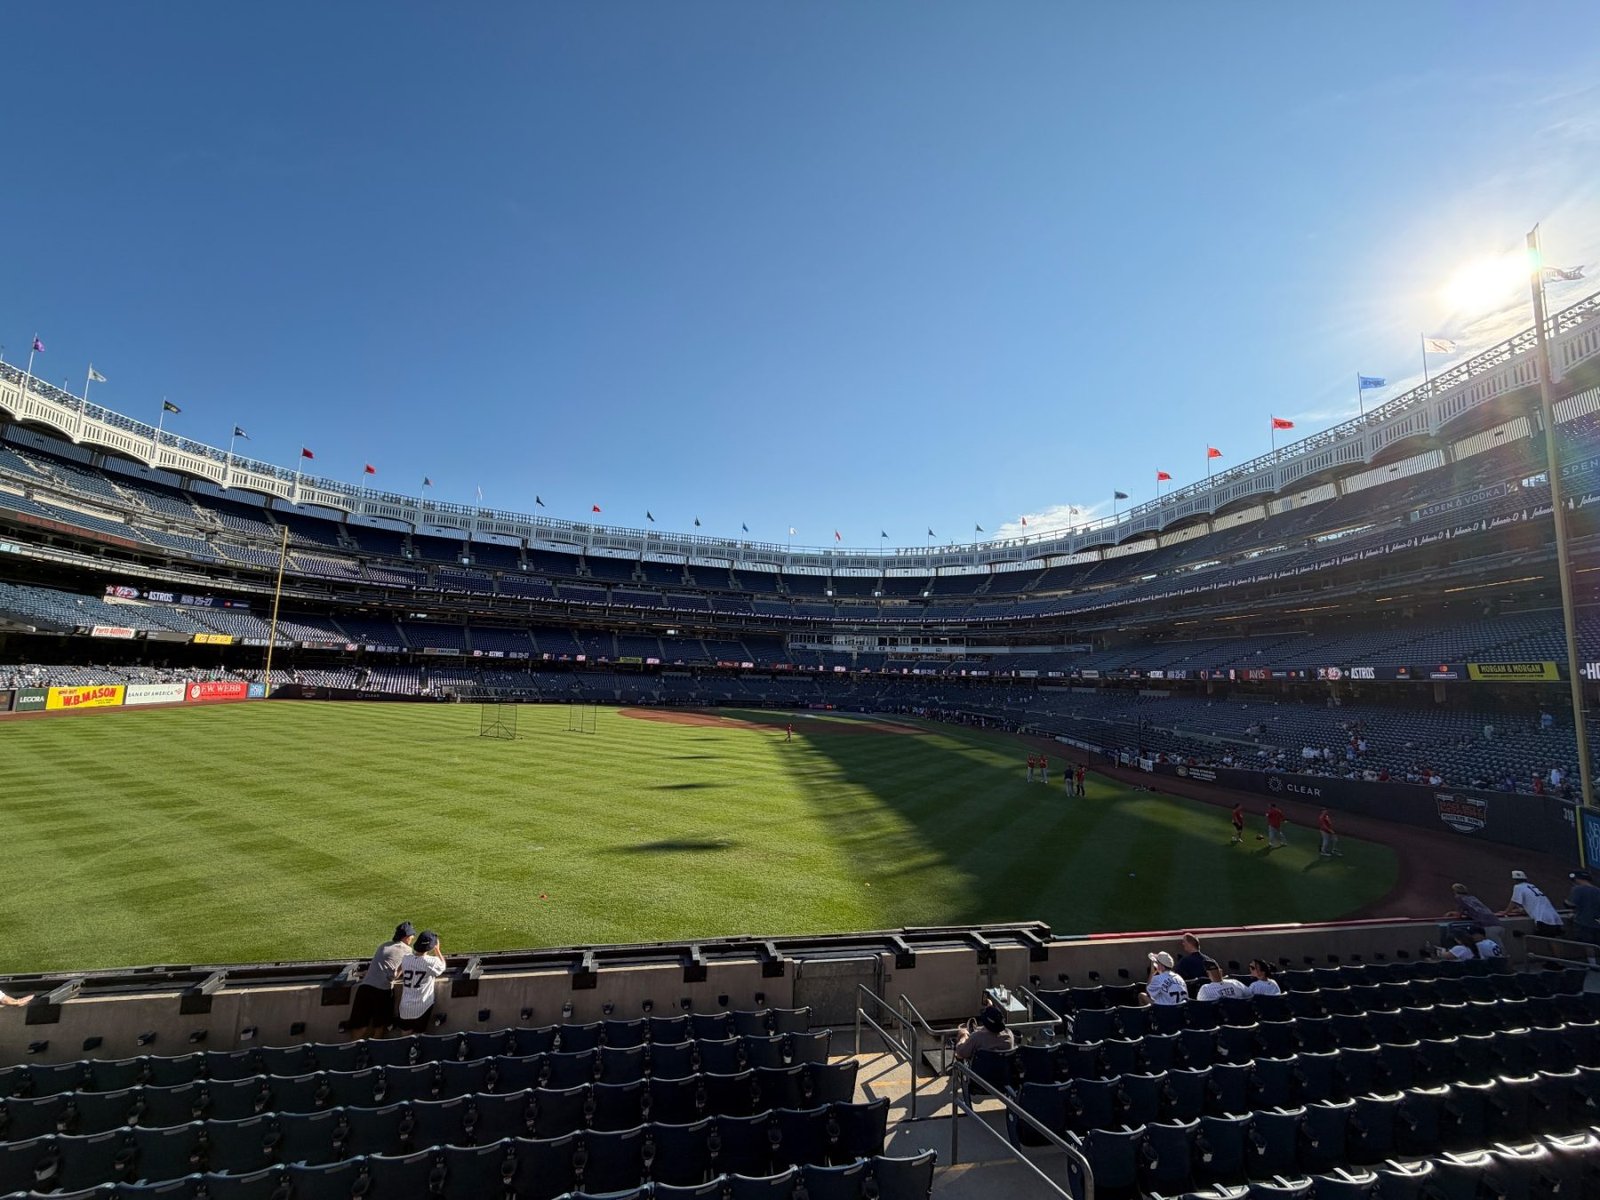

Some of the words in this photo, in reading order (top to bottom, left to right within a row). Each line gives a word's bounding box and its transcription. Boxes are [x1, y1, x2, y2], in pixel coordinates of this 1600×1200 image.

[1562, 459, 1599, 476] SPEN
[1422, 501, 1453, 517] ASPEN
[1464, 488, 1500, 505] VODKA
[148, 591, 174, 602] ASTROS
[1249, 669, 1266, 679] AVIS
[1351, 667, 1376, 679] ASTROS
[1481, 664, 1506, 673] MORGAN
[1507, 664, 1513, 673] &
[1513, 664, 1541, 673] MORGAN
[216, 683, 241, 693] WEBB
[128, 690, 143, 698] BANK
[1287, 783, 1321, 798] CLEAR
[403, 970, 427, 988] 27
